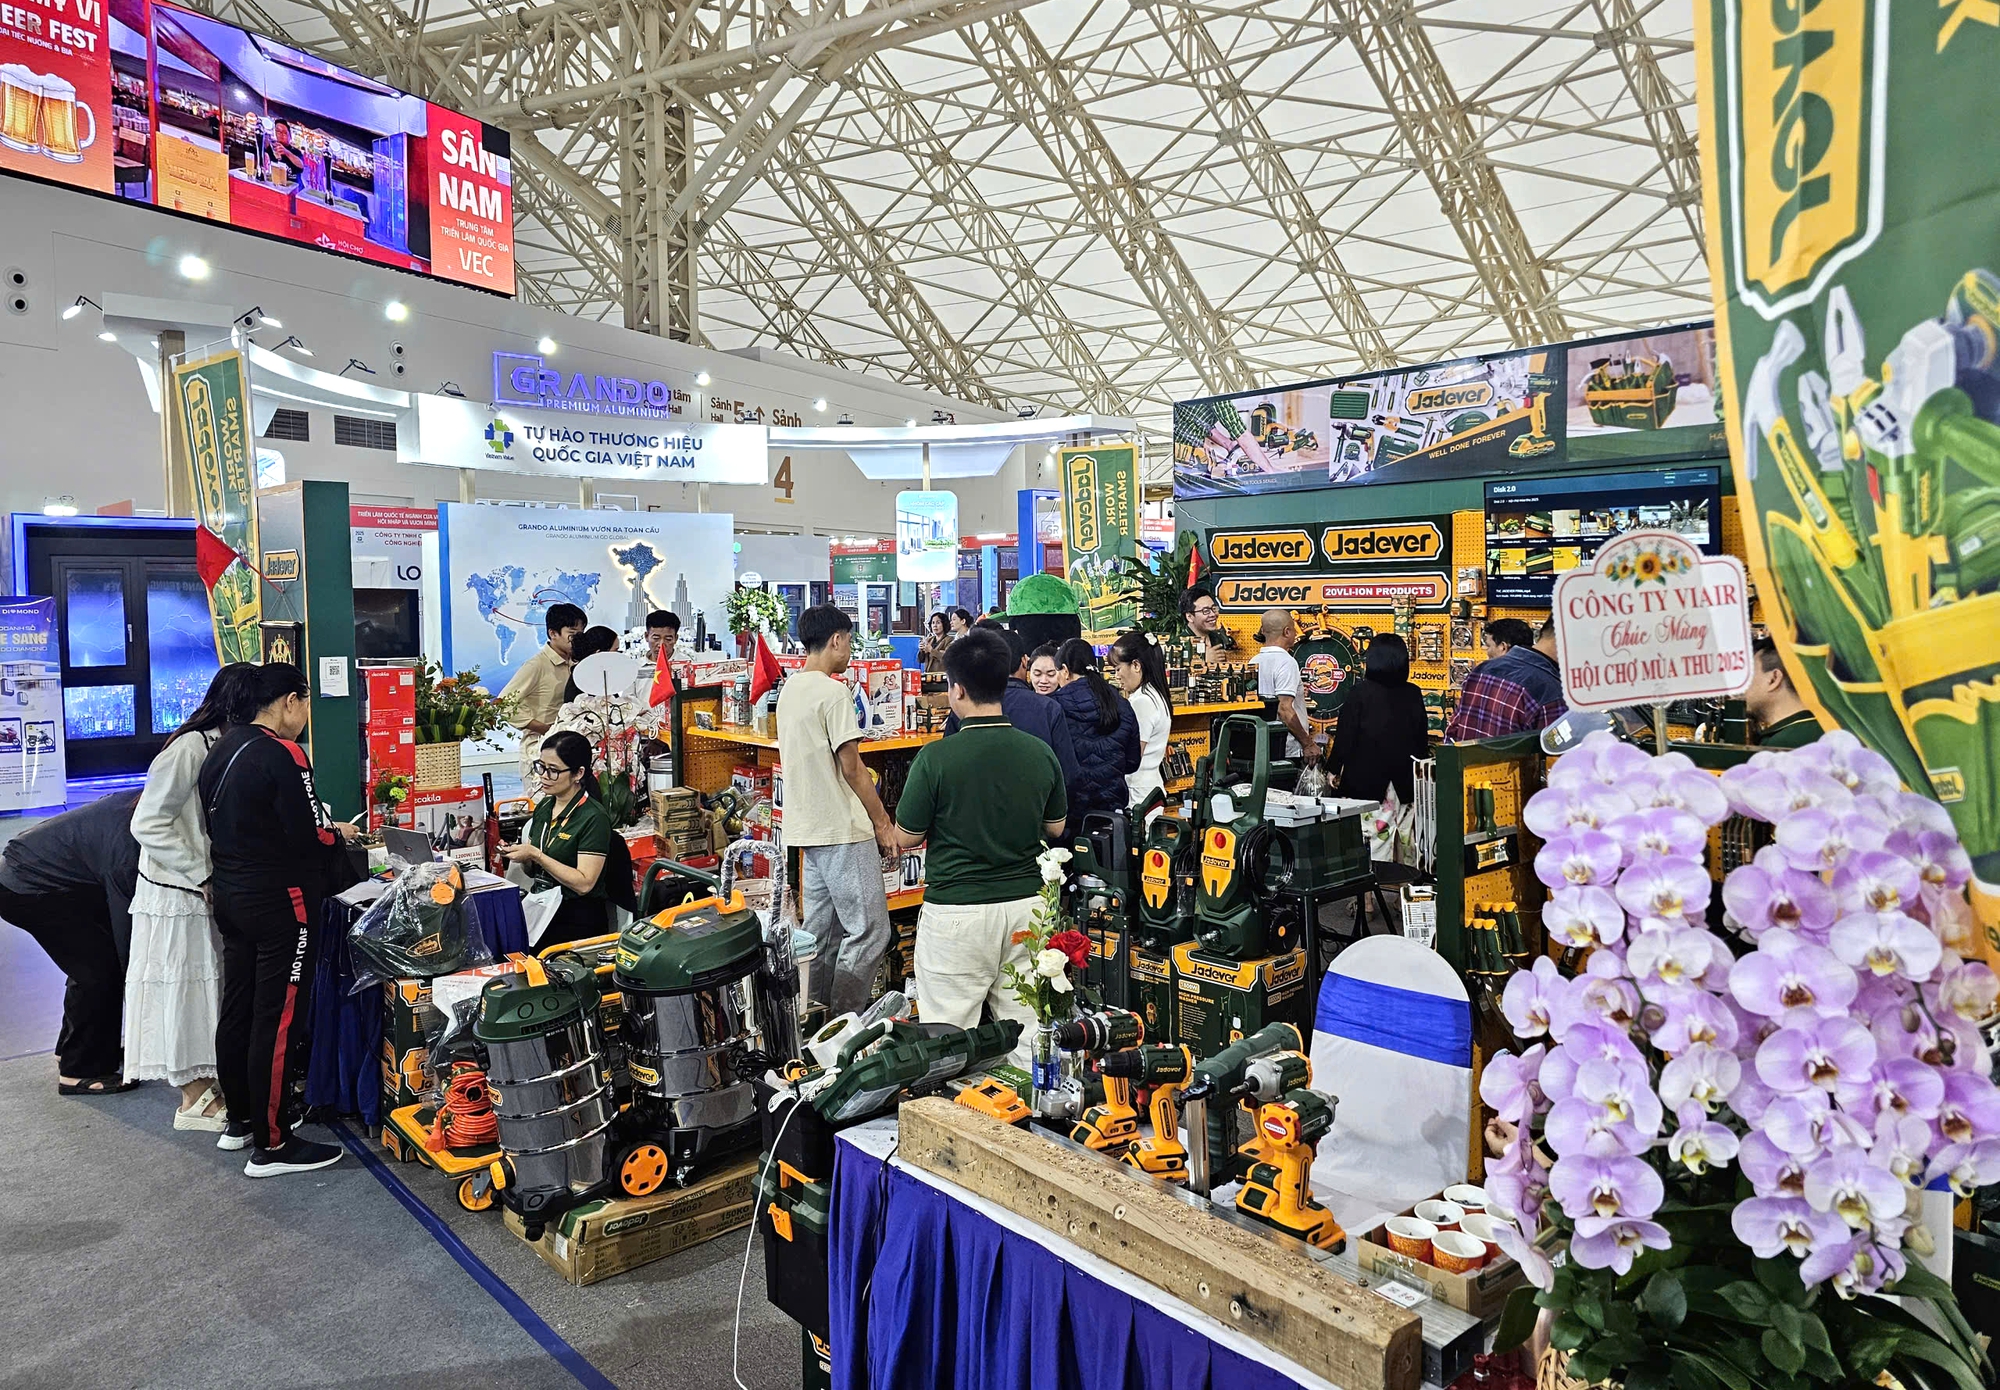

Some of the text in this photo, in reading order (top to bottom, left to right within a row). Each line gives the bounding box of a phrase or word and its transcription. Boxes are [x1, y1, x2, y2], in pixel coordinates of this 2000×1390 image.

[49, 19, 97, 53] FEST
[441, 129, 497, 179] SÂN
[439, 172, 503, 224] NAM
[456, 218, 478, 233] TRUNG
[498, 243, 510, 254] GIA
[459, 247, 494, 278] VEC
[511, 366, 669, 407] GRANDO
[673, 388, 692, 403] tâm
[546, 399, 670, 419] PREMIUM ALUMINIUM
[668, 404, 682, 415] Hall
[711, 396, 732, 411] Sảnh
[1412, 388, 1486, 411] Jadever
[711, 413, 723, 423] Hall
[734, 401, 745, 424] 5
[772, 406, 802, 428] Sảnh
[523, 424, 704, 453] TỰ HÀO THƯƠNG HIỆU
[1429, 429, 1506, 460] WELL DONE FOREVER
[532, 442, 695, 470] QUỐC GIA VIỆT NAM
[774, 455, 795, 498] 4
[518, 523, 549, 531] GRANDO
[549, 524, 589, 533] ALUMINIUM
[1219, 538, 1305, 560] Jadever
[1332, 531, 1432, 556] Jadever
[1229, 583, 1433, 602] Jadever 20VLI-ION PRODUCTS
[1569, 584, 1738, 620] CÔNG TY VIAIR
[12, 632, 48, 645] SANG
[1601, 620, 1650, 657] Chúc
[1410, 671, 1447, 681] Jadever
[1570, 651, 1746, 692] HỘI CHỢ MÙA THU 2025
[1137, 960, 1166, 974] Jadever
[1190, 963, 1237, 984] Jadever
[1270, 966, 1301, 987] Jadever
[1190, 994, 1215, 1005] PRESSURE
[1114, 1032, 1138, 1041] Jadever
[1286, 1074, 1308, 1088] Jadever
[721, 1205, 750, 1222] 150KG
